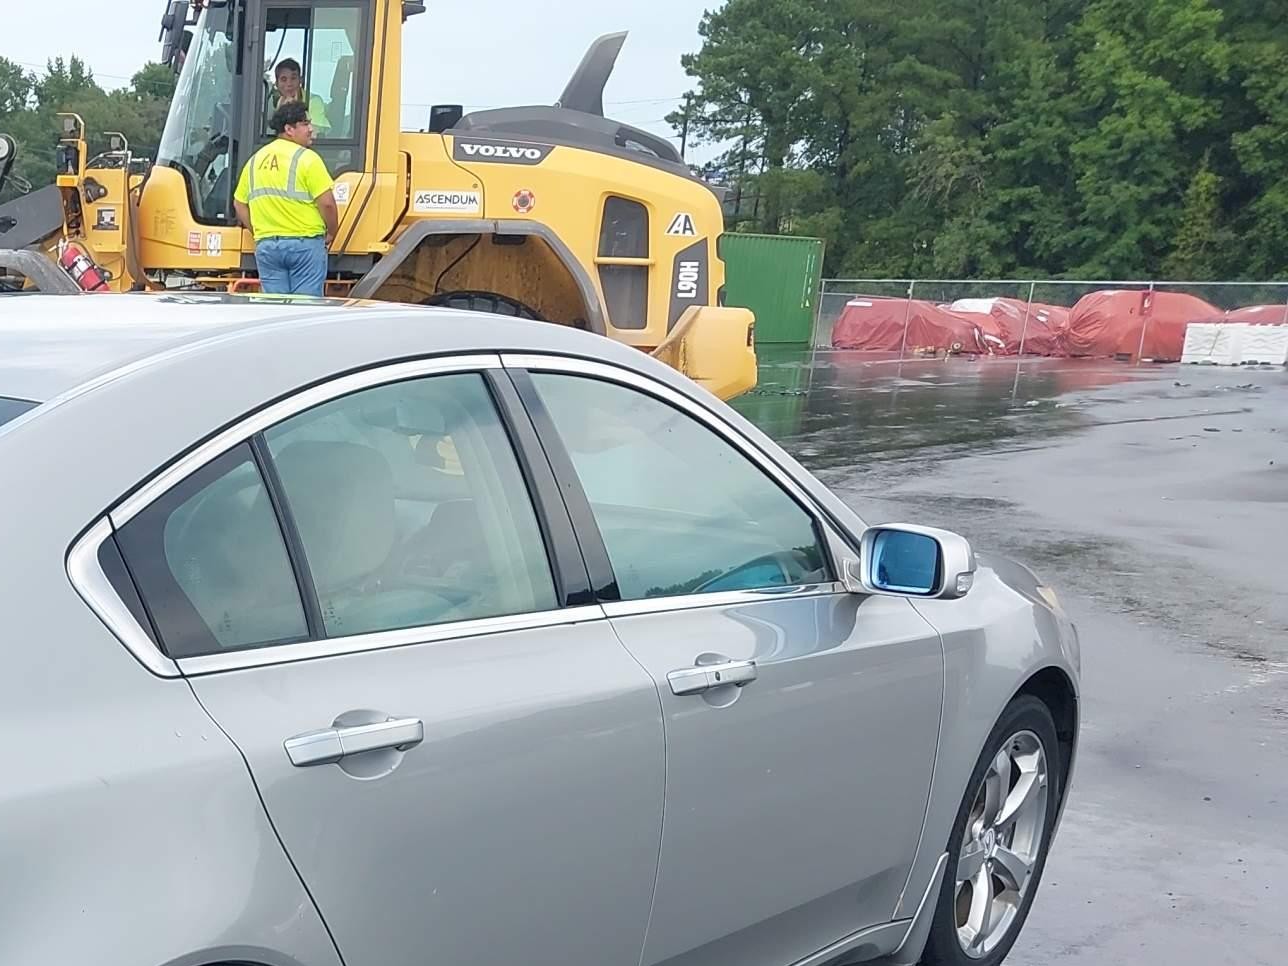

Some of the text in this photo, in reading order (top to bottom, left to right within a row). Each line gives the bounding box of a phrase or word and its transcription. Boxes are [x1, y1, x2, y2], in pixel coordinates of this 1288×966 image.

[460, 144, 541, 159] VOLVO
[416, 194, 478, 205] ASCENDUM
[676, 261, 699, 298] L90H
